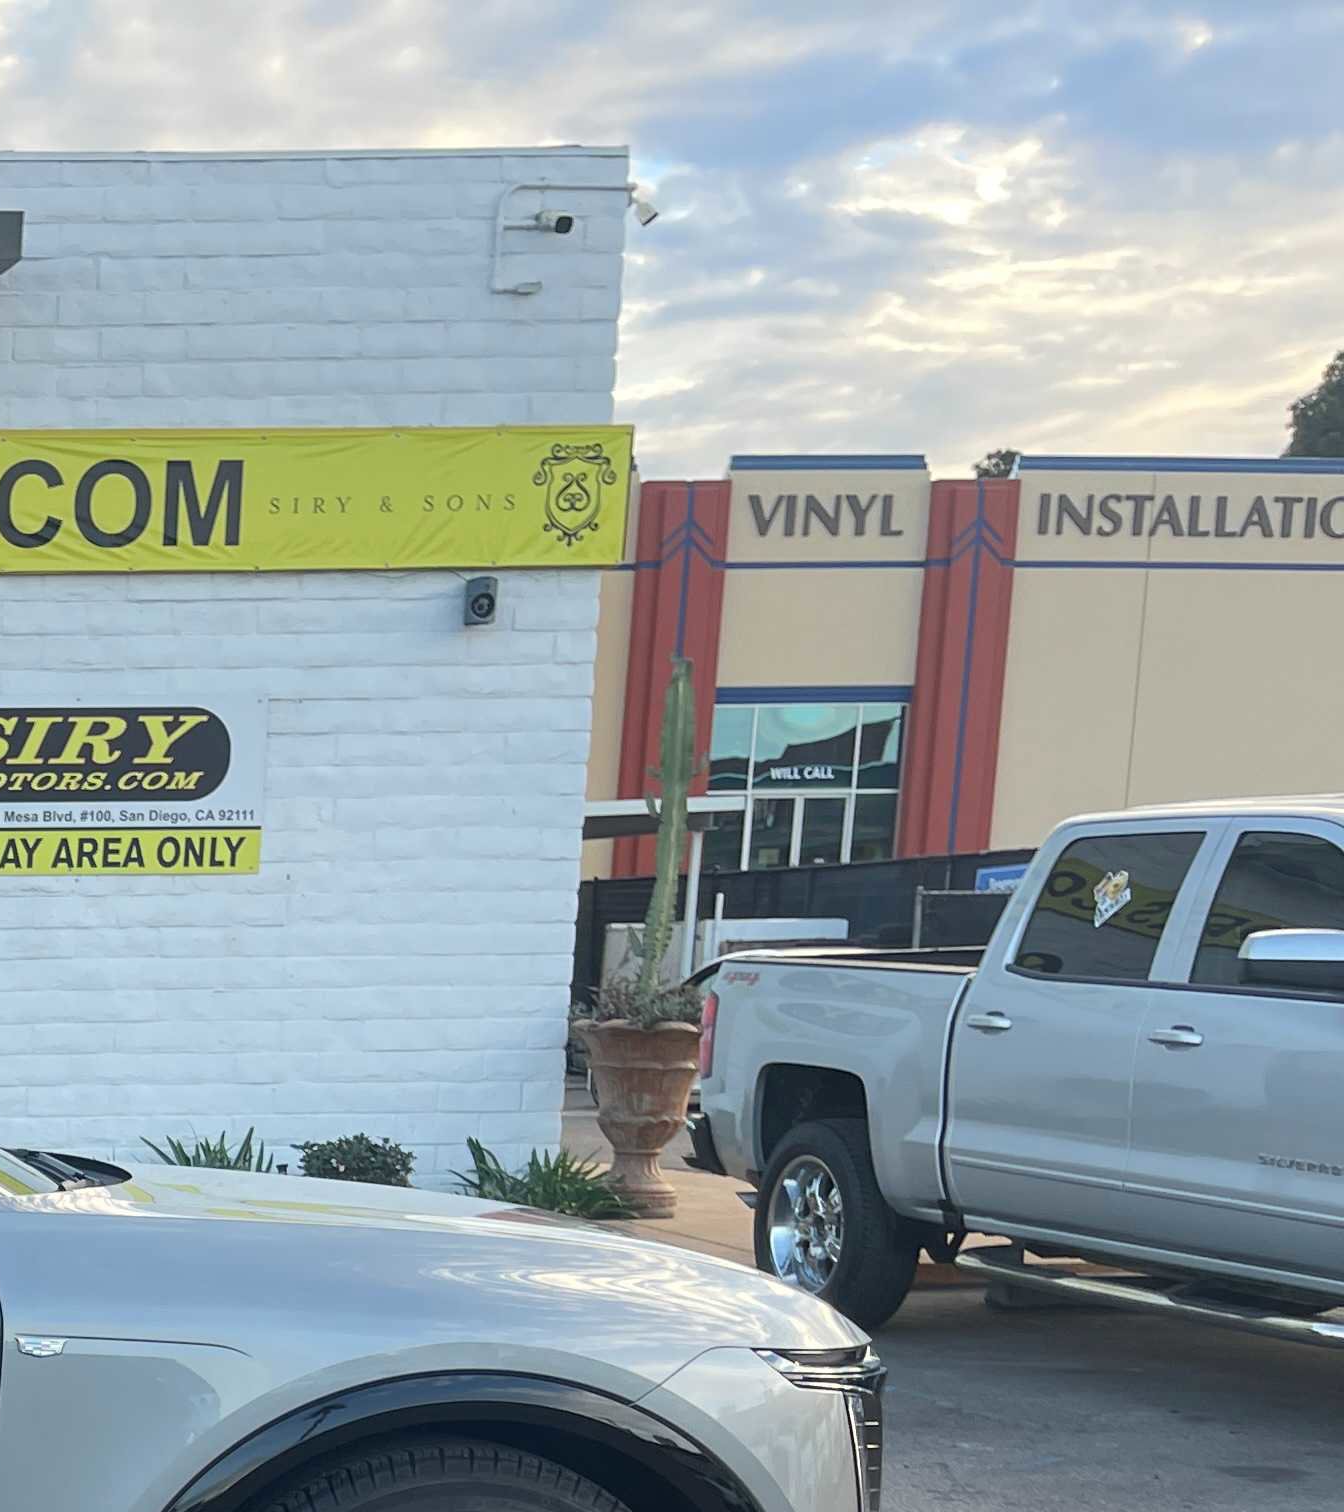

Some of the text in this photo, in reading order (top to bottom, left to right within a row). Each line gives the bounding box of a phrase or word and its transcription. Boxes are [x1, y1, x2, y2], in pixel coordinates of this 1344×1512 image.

[268, 494, 517, 515] SIRY & SONS
[747, 493, 905, 539] VINYL
[770, 766, 835, 780] WILL CALL
[4, 811, 39, 823] Mesa
[42, 810, 76, 824] Blvd,
[80, 810, 115, 824] #100,
[119, 810, 145, 822] San
[149, 810, 191, 824] Diego,
[195, 809, 215, 822] CA
[218, 809, 255, 822] 92111
[51, 837, 145, 869] AREA
[156, 836, 246, 868] ONLY
